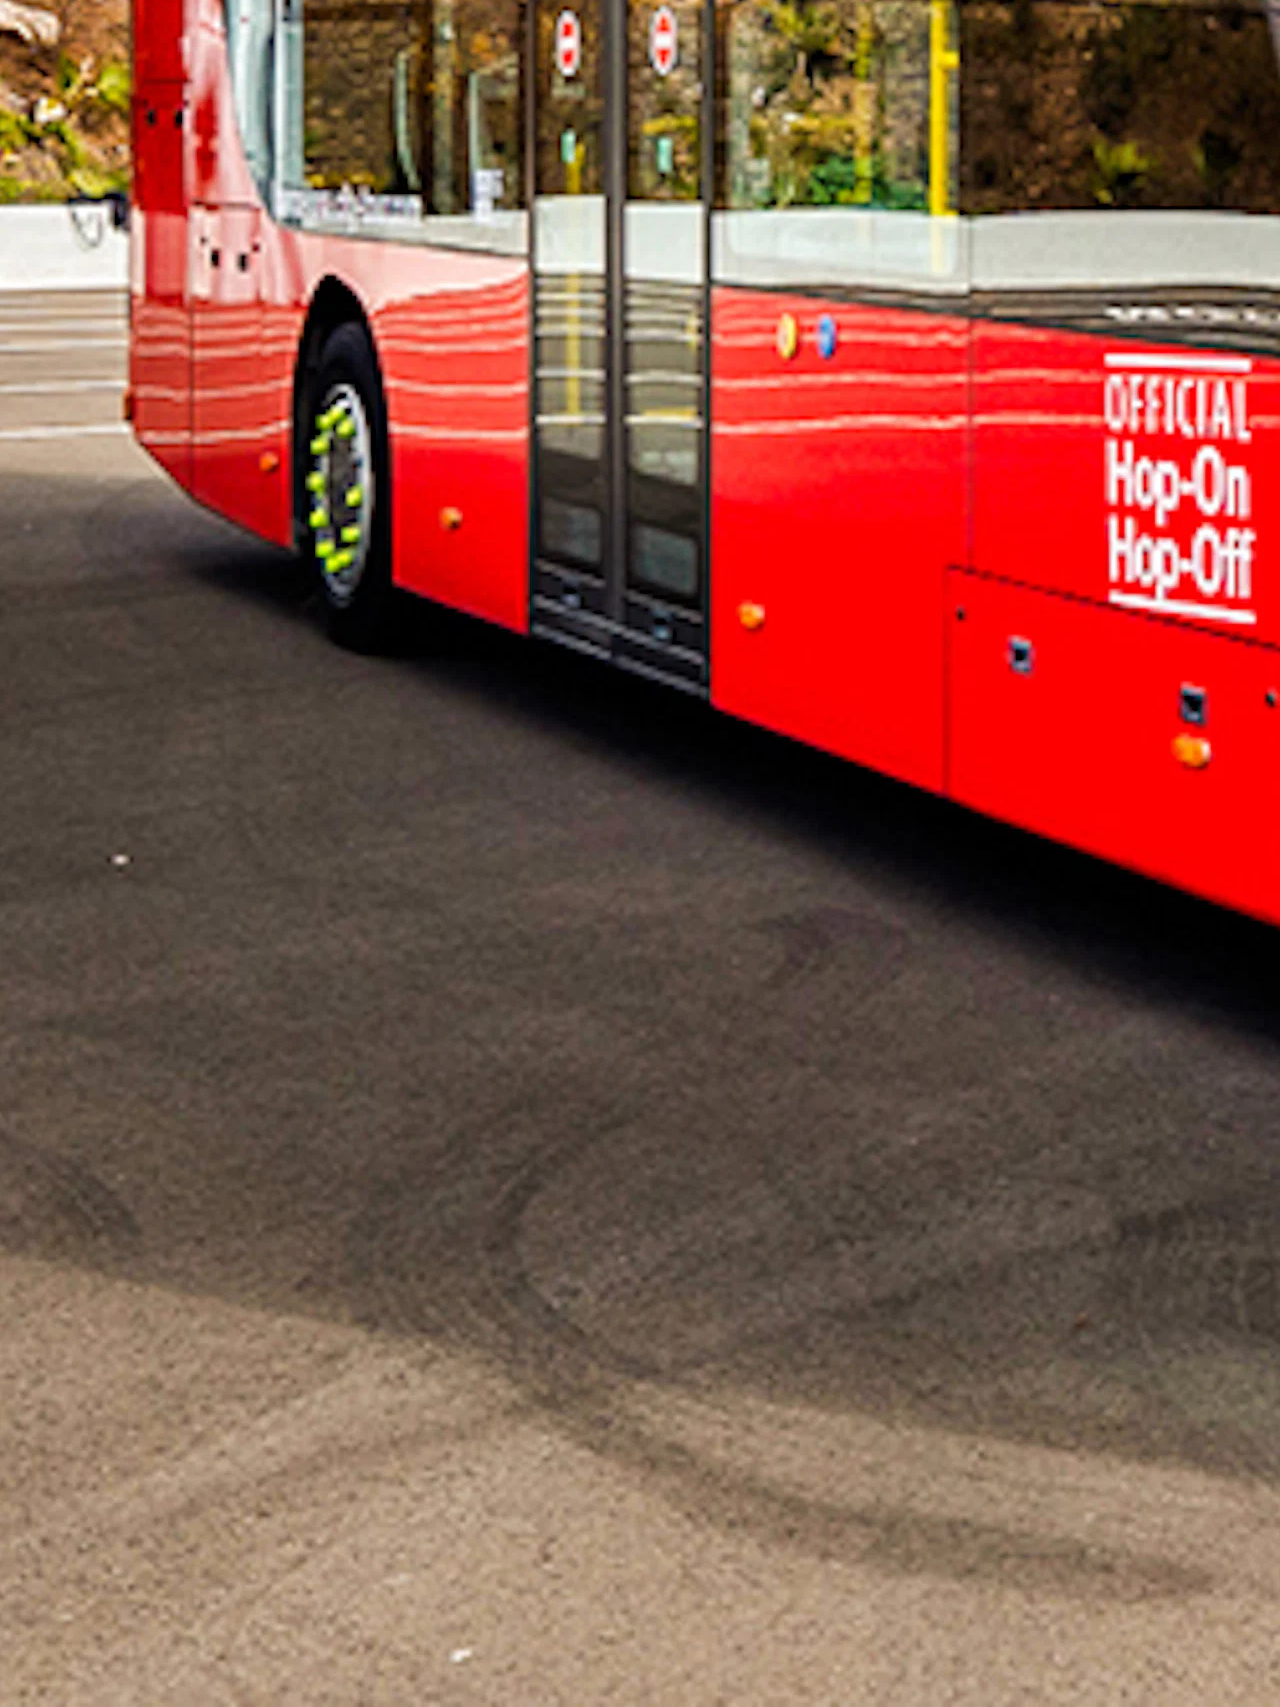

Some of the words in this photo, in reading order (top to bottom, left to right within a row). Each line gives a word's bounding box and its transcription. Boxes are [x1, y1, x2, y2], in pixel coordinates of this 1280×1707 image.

[1104, 373, 1252, 444] OFFICIAL
[1104, 439, 1252, 527] Hop-On
[1107, 513, 1256, 600] Hop-Off
